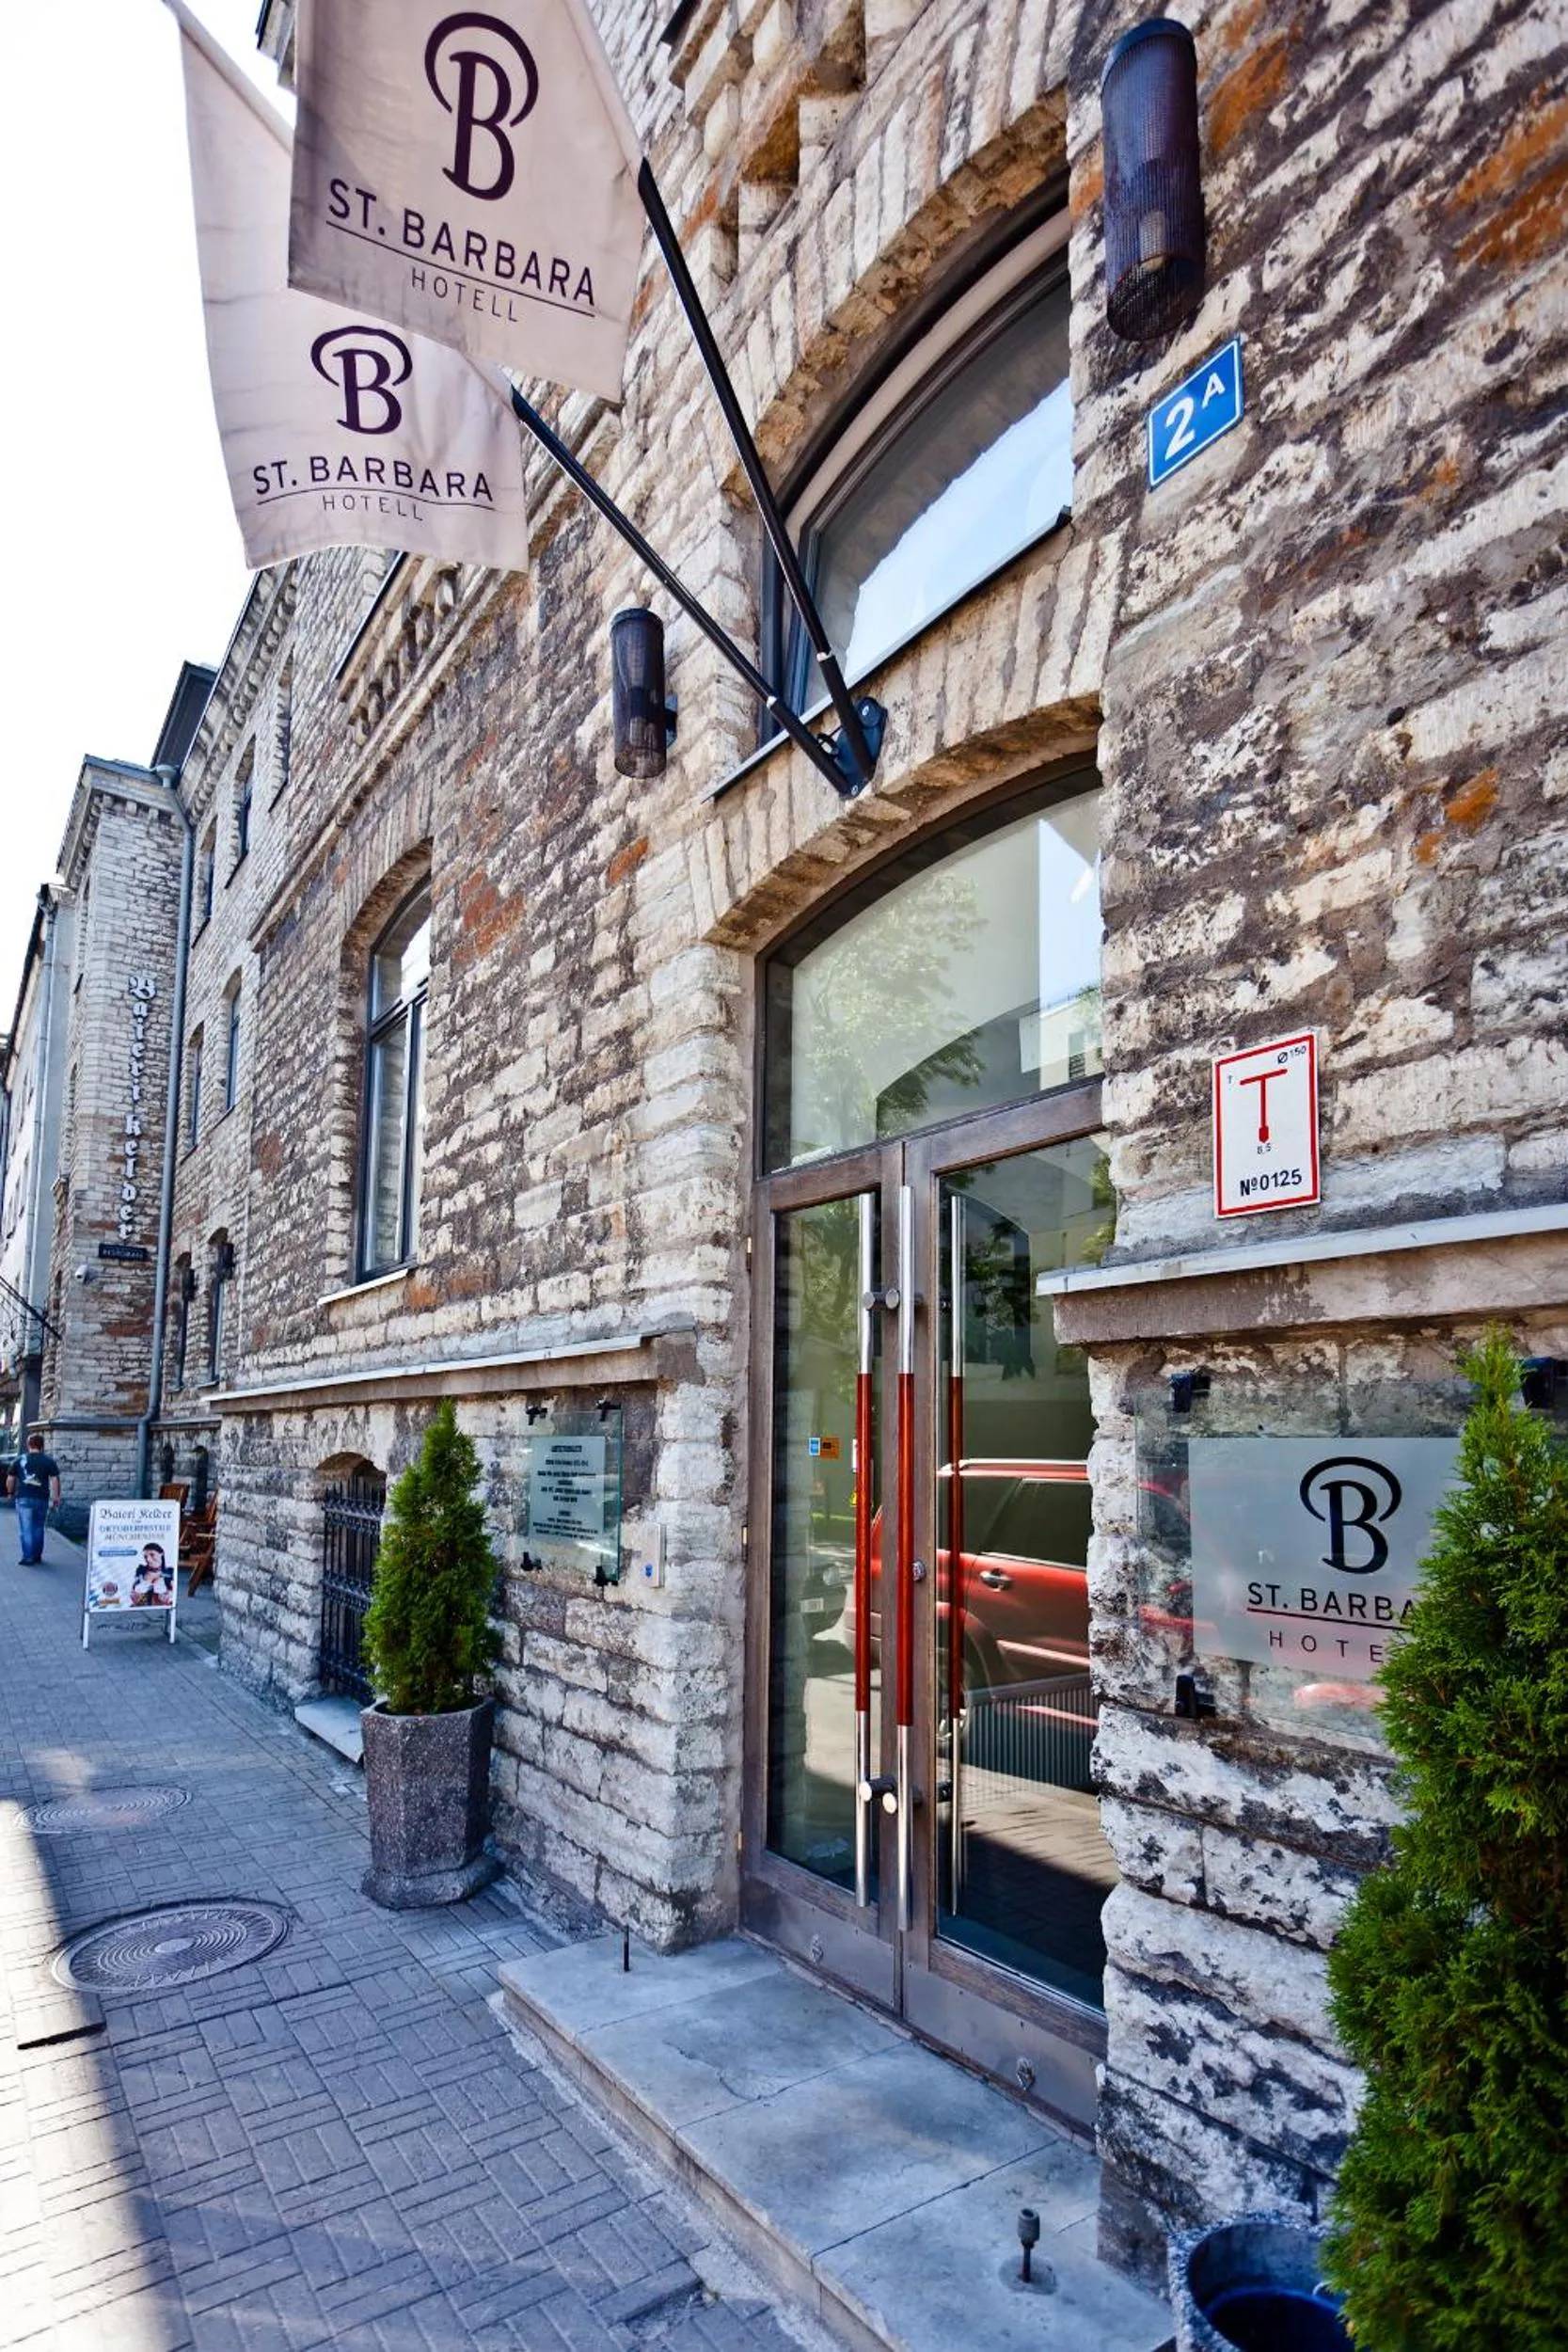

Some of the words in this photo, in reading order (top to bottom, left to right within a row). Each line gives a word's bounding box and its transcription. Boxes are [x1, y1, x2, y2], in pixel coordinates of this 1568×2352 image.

[328, 178, 386, 236] ST.
[403, 207, 594, 307] BARBARA
[411, 266, 519, 323] HOTELL
[253, 460, 297, 495] ST.
[309, 455, 494, 502] BARBARA
[323, 494, 423, 521] HOTELL
[1247, 1582, 1288, 1609] ST.
